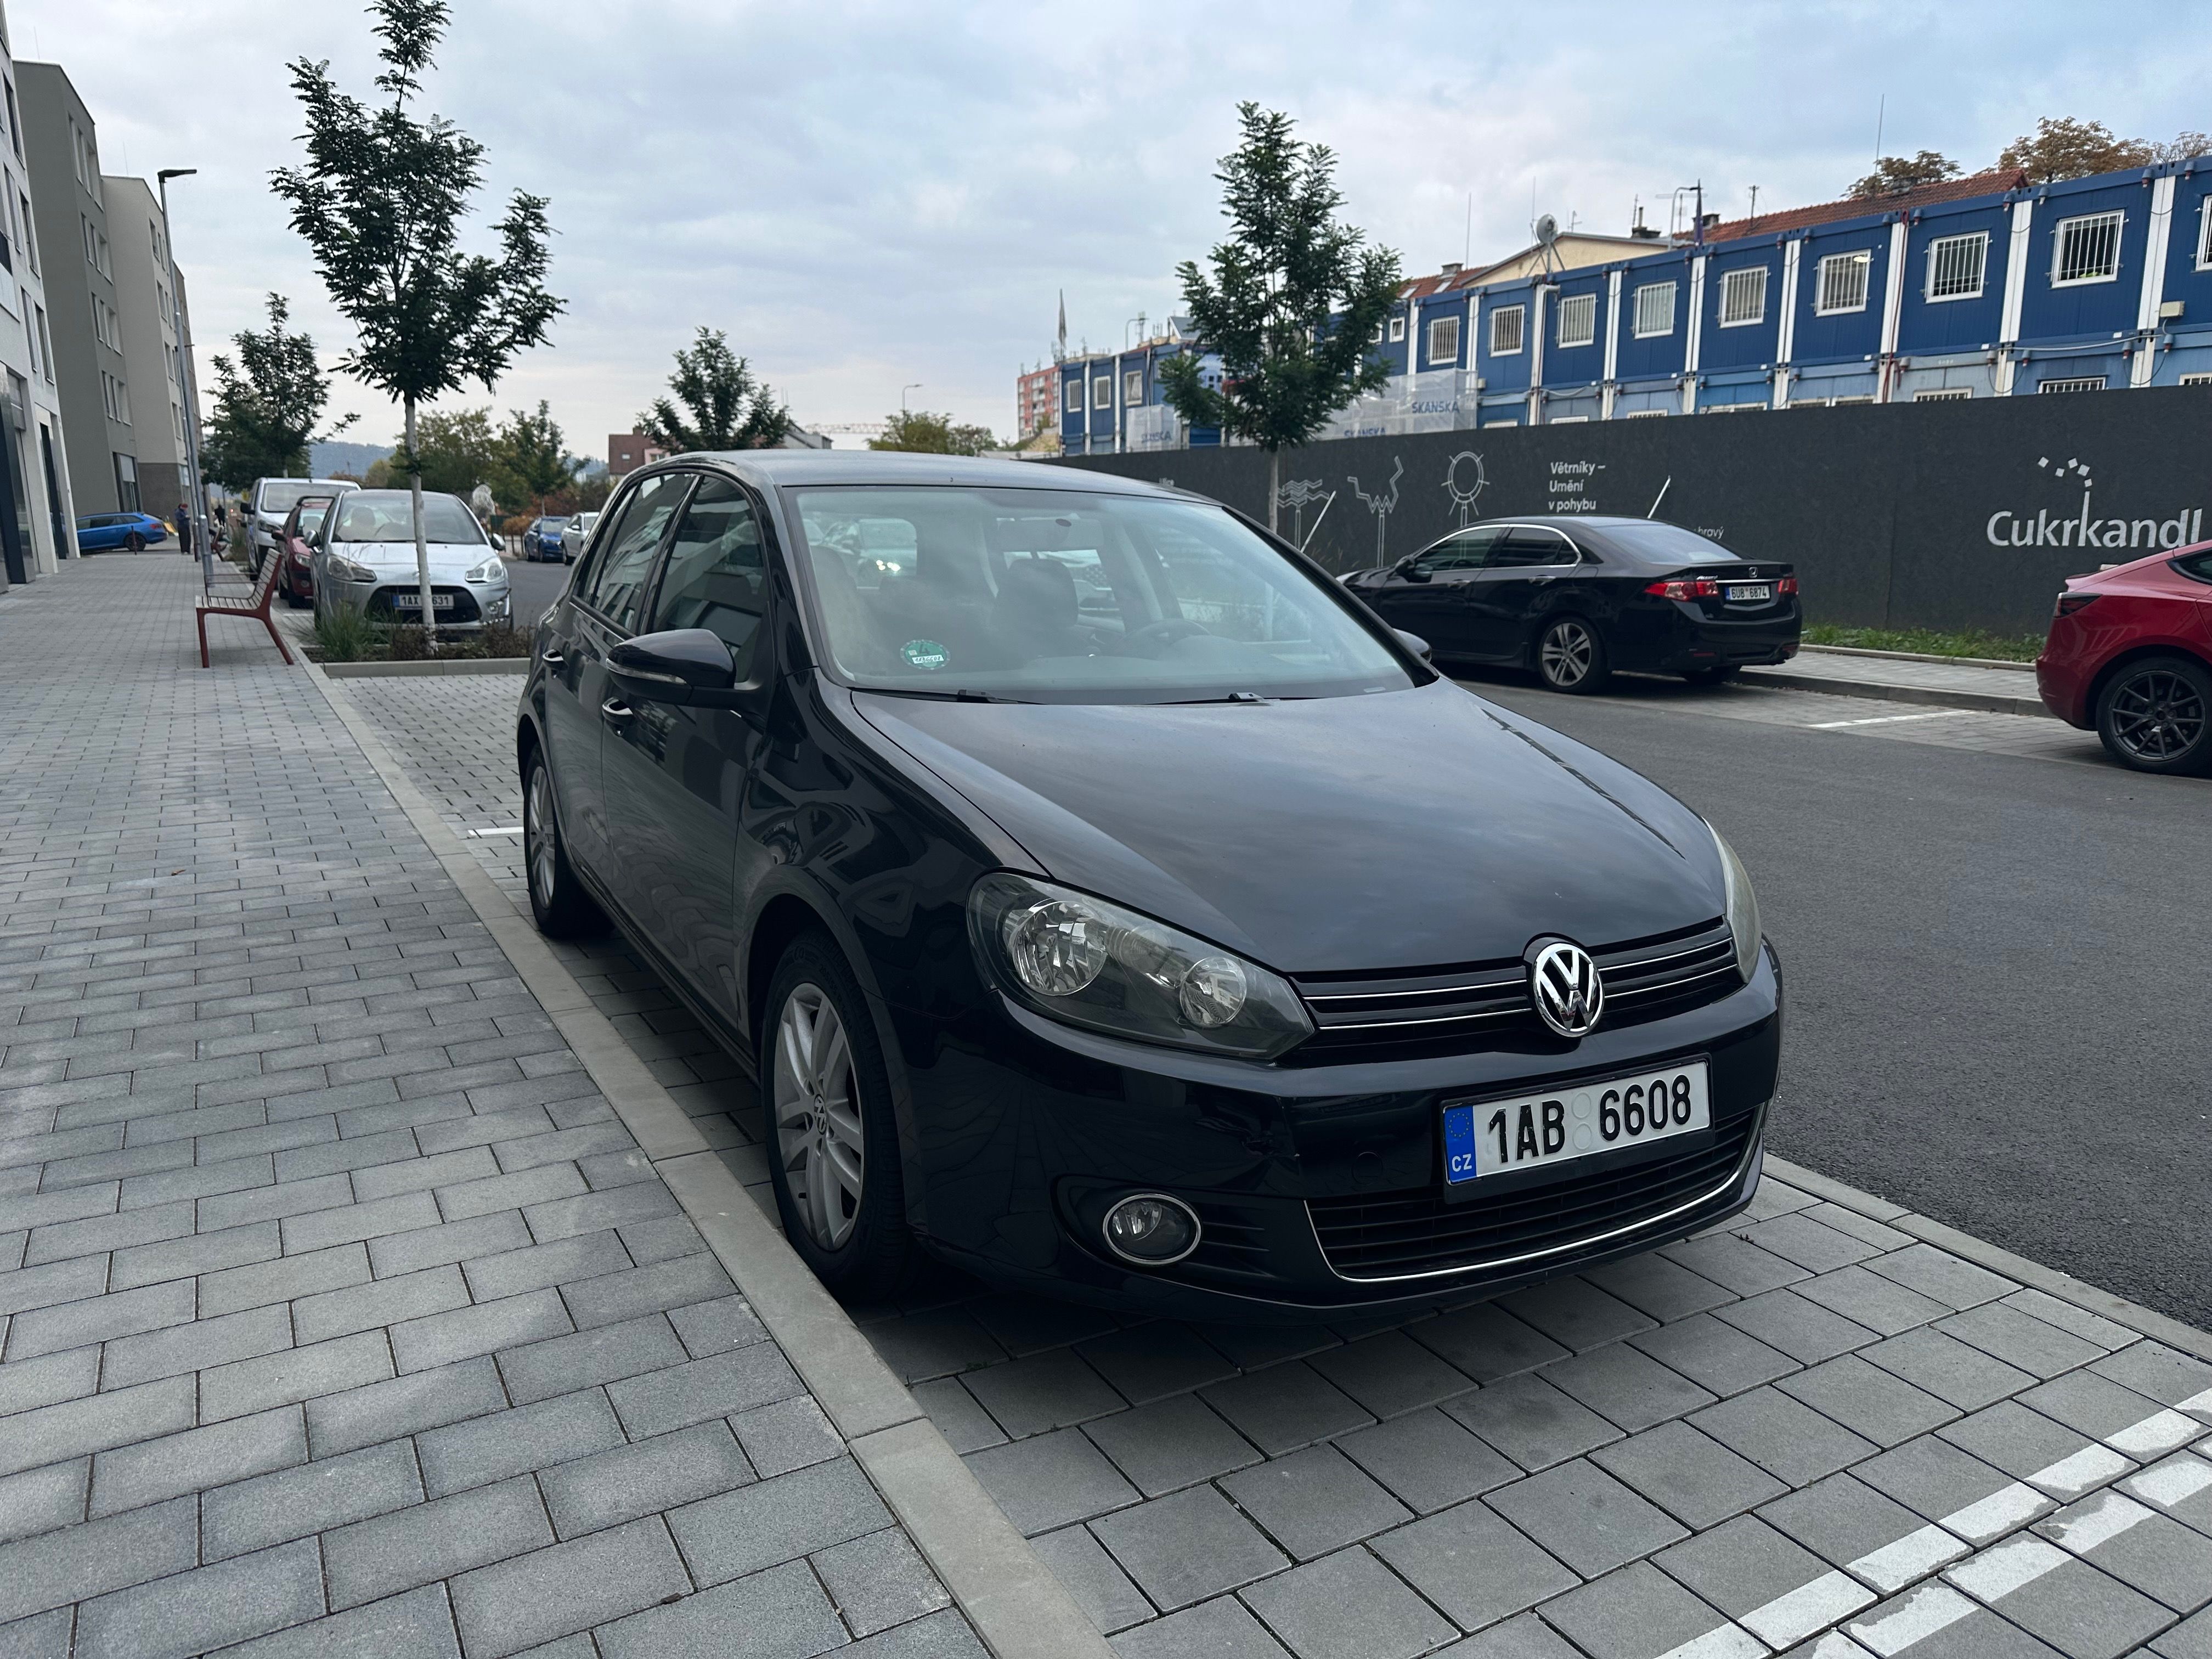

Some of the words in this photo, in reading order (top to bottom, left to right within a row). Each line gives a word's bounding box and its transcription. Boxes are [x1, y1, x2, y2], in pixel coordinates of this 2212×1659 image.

[1412, 401, 1460, 414] SKANSKA
[1550, 461, 1595, 476] Větrníky
[1549, 479, 1584, 492] Umění
[1548, 500, 1555, 510] v
[1556, 498, 1596, 512] pohybu
[1987, 491, 2202, 548] Cukrkandl
[402, 596, 419, 605] 1AX
[432, 596, 449, 605] 631
[1534, 943, 1604, 1037] VW
[1488, 1099, 1566, 1164] 1AB
[1599, 1074, 1691, 1142] 6608
[1451, 1153, 1472, 1173] CZ
